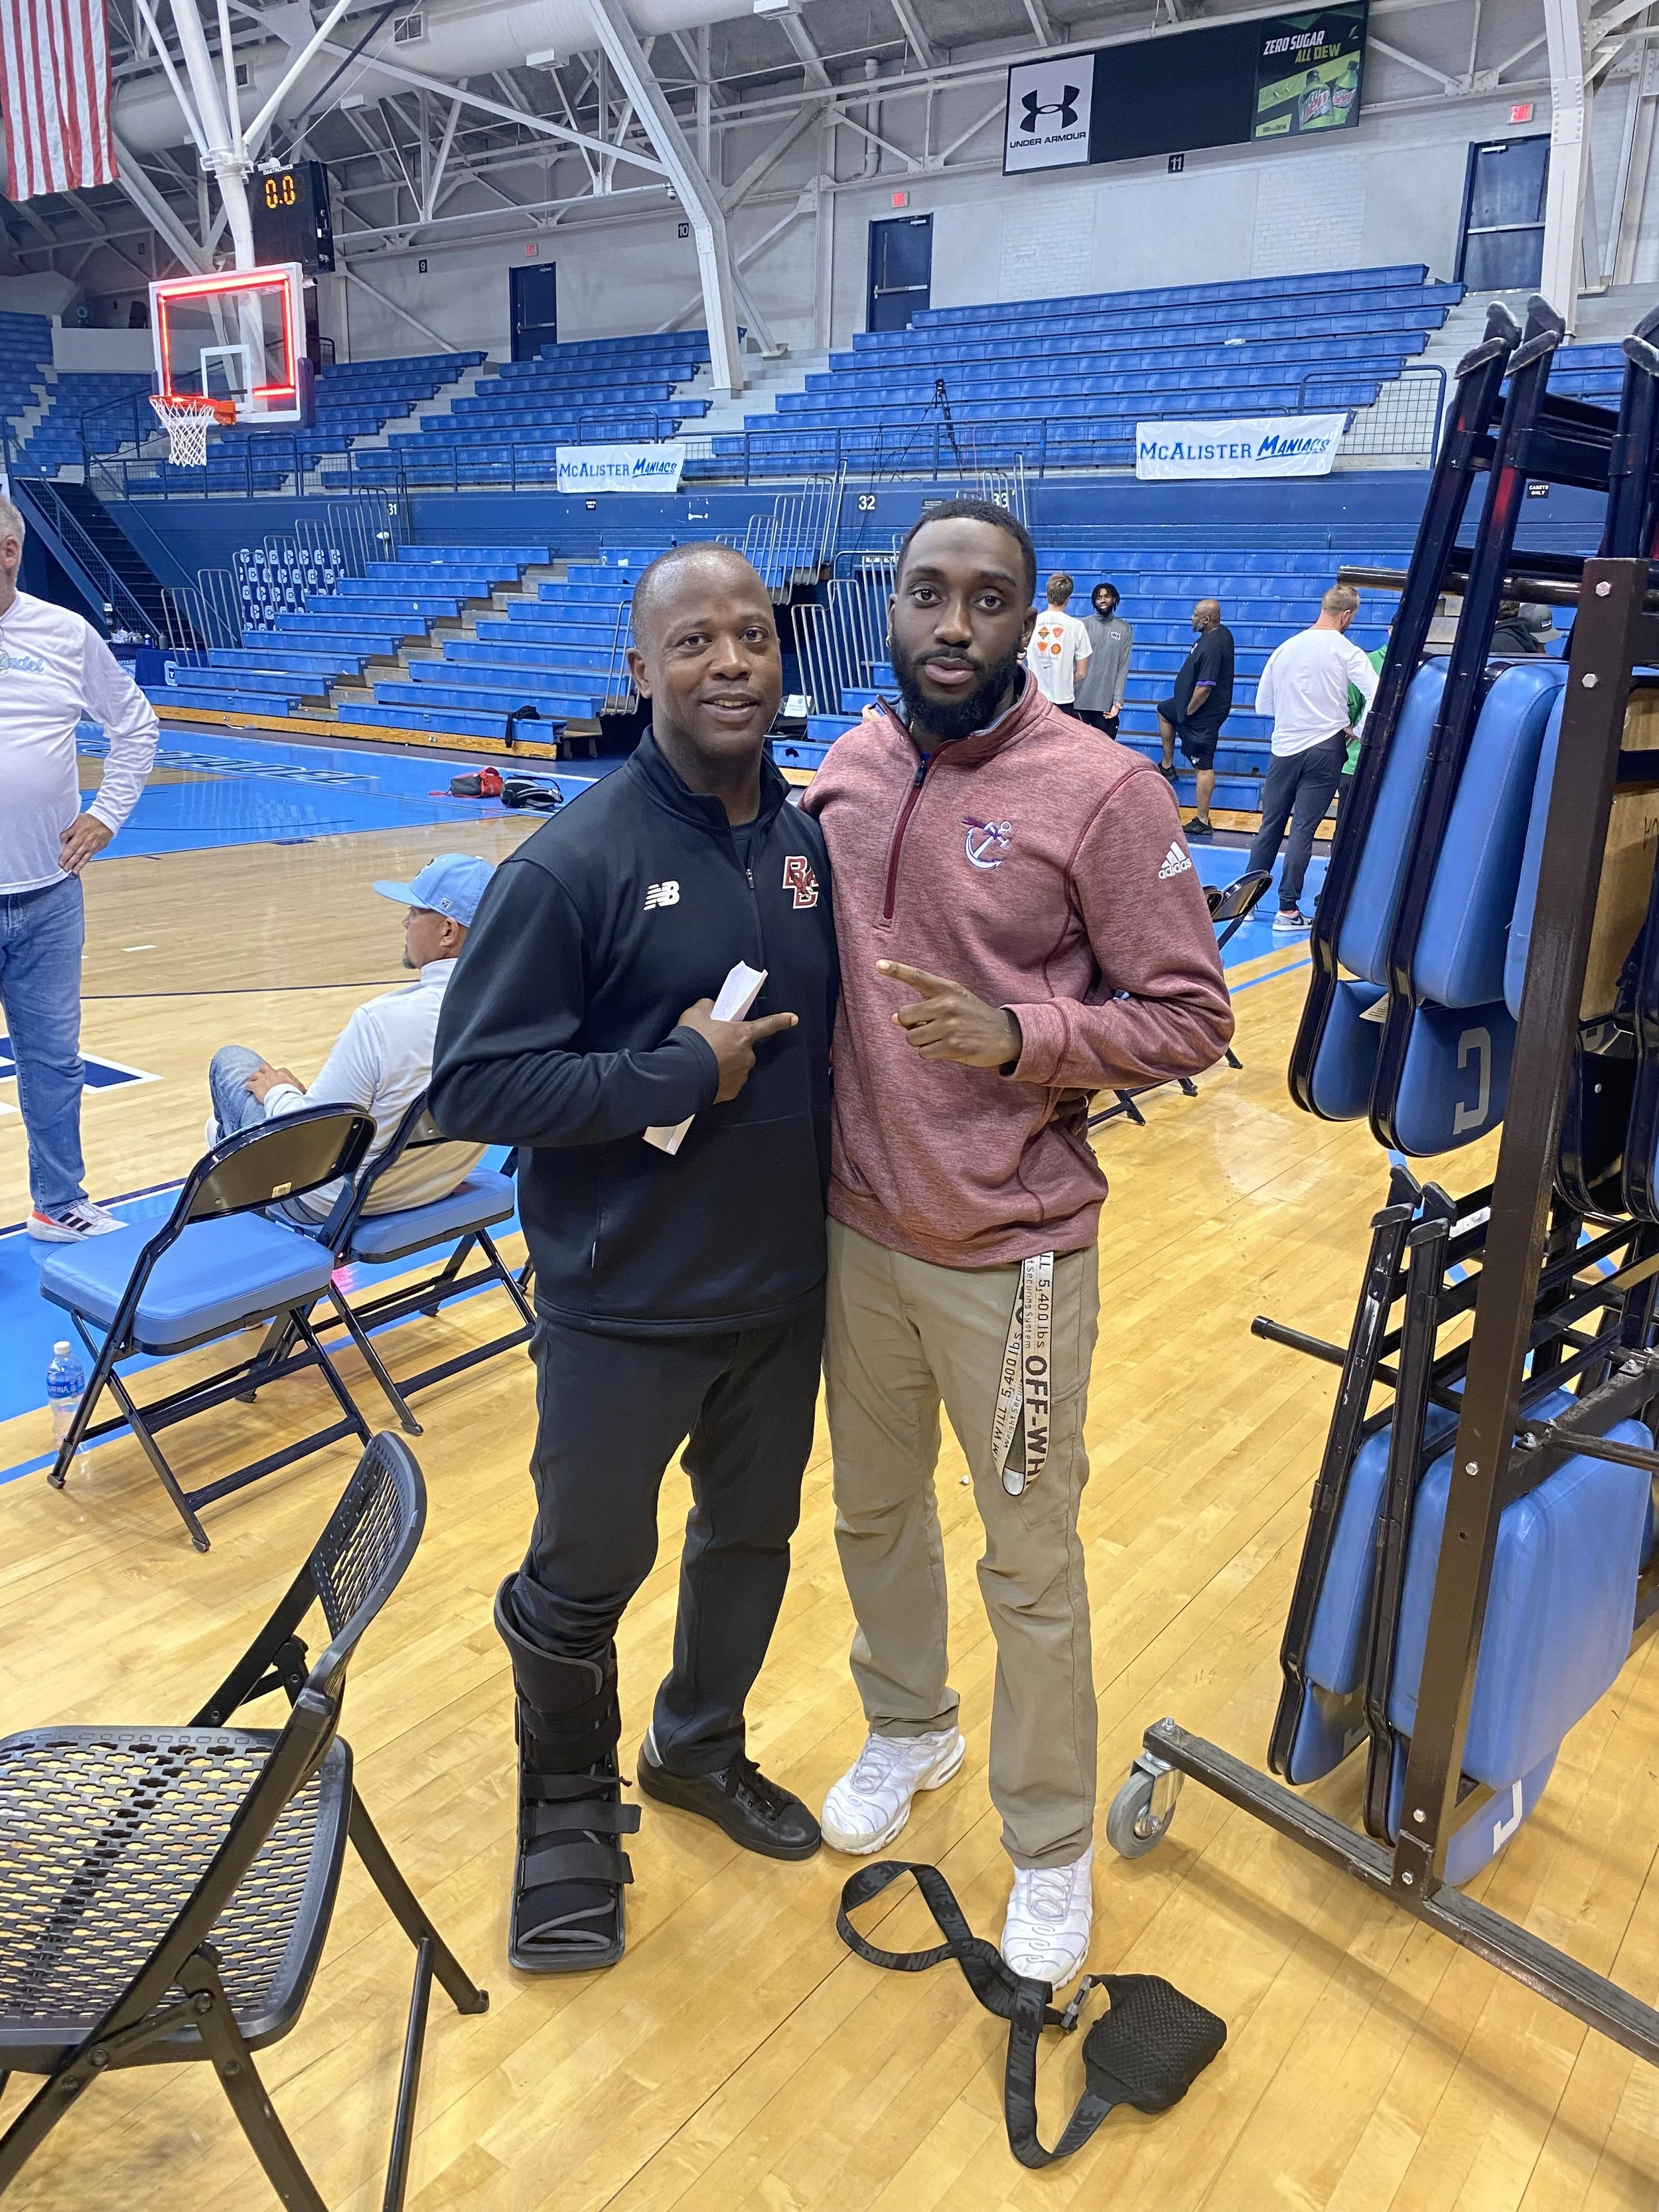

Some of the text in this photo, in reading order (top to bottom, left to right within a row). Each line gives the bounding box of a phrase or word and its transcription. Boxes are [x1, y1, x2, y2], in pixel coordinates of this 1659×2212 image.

[1263, 31, 1325, 56] ZERO SUGAR
[1295, 42, 1341, 63] ALL DEW
[1010, 131, 1086, 148] UNDER ARMOUR
[1171, 157, 1181, 171] 11
[265, 175, 296, 208] 0.0
[678, 226, 688, 236] 10
[420, 261, 425, 271] 9
[1256, 435, 1330, 459] MANIACS
[632, 458, 677, 477] MANIACS
[388, 503, 397, 515] 31
[858, 495, 875, 510] 32
[1158, 857, 1192, 879] adidas
[1025, 1267, 1035, 1309] Securing
[1036, 1280, 1050, 1321] 5,400
[1024, 1312, 1033, 1349] System
[1037, 1327, 1049, 1349] lbs
[1008, 1332, 1023, 1356] lbs
[49, 1385, 70, 1394] AFINA
[1000, 1359, 1017, 1398] 5,400
[904, 1944, 953, 1970] NIKE
[1009, 2023, 1035, 2085] NIKE
